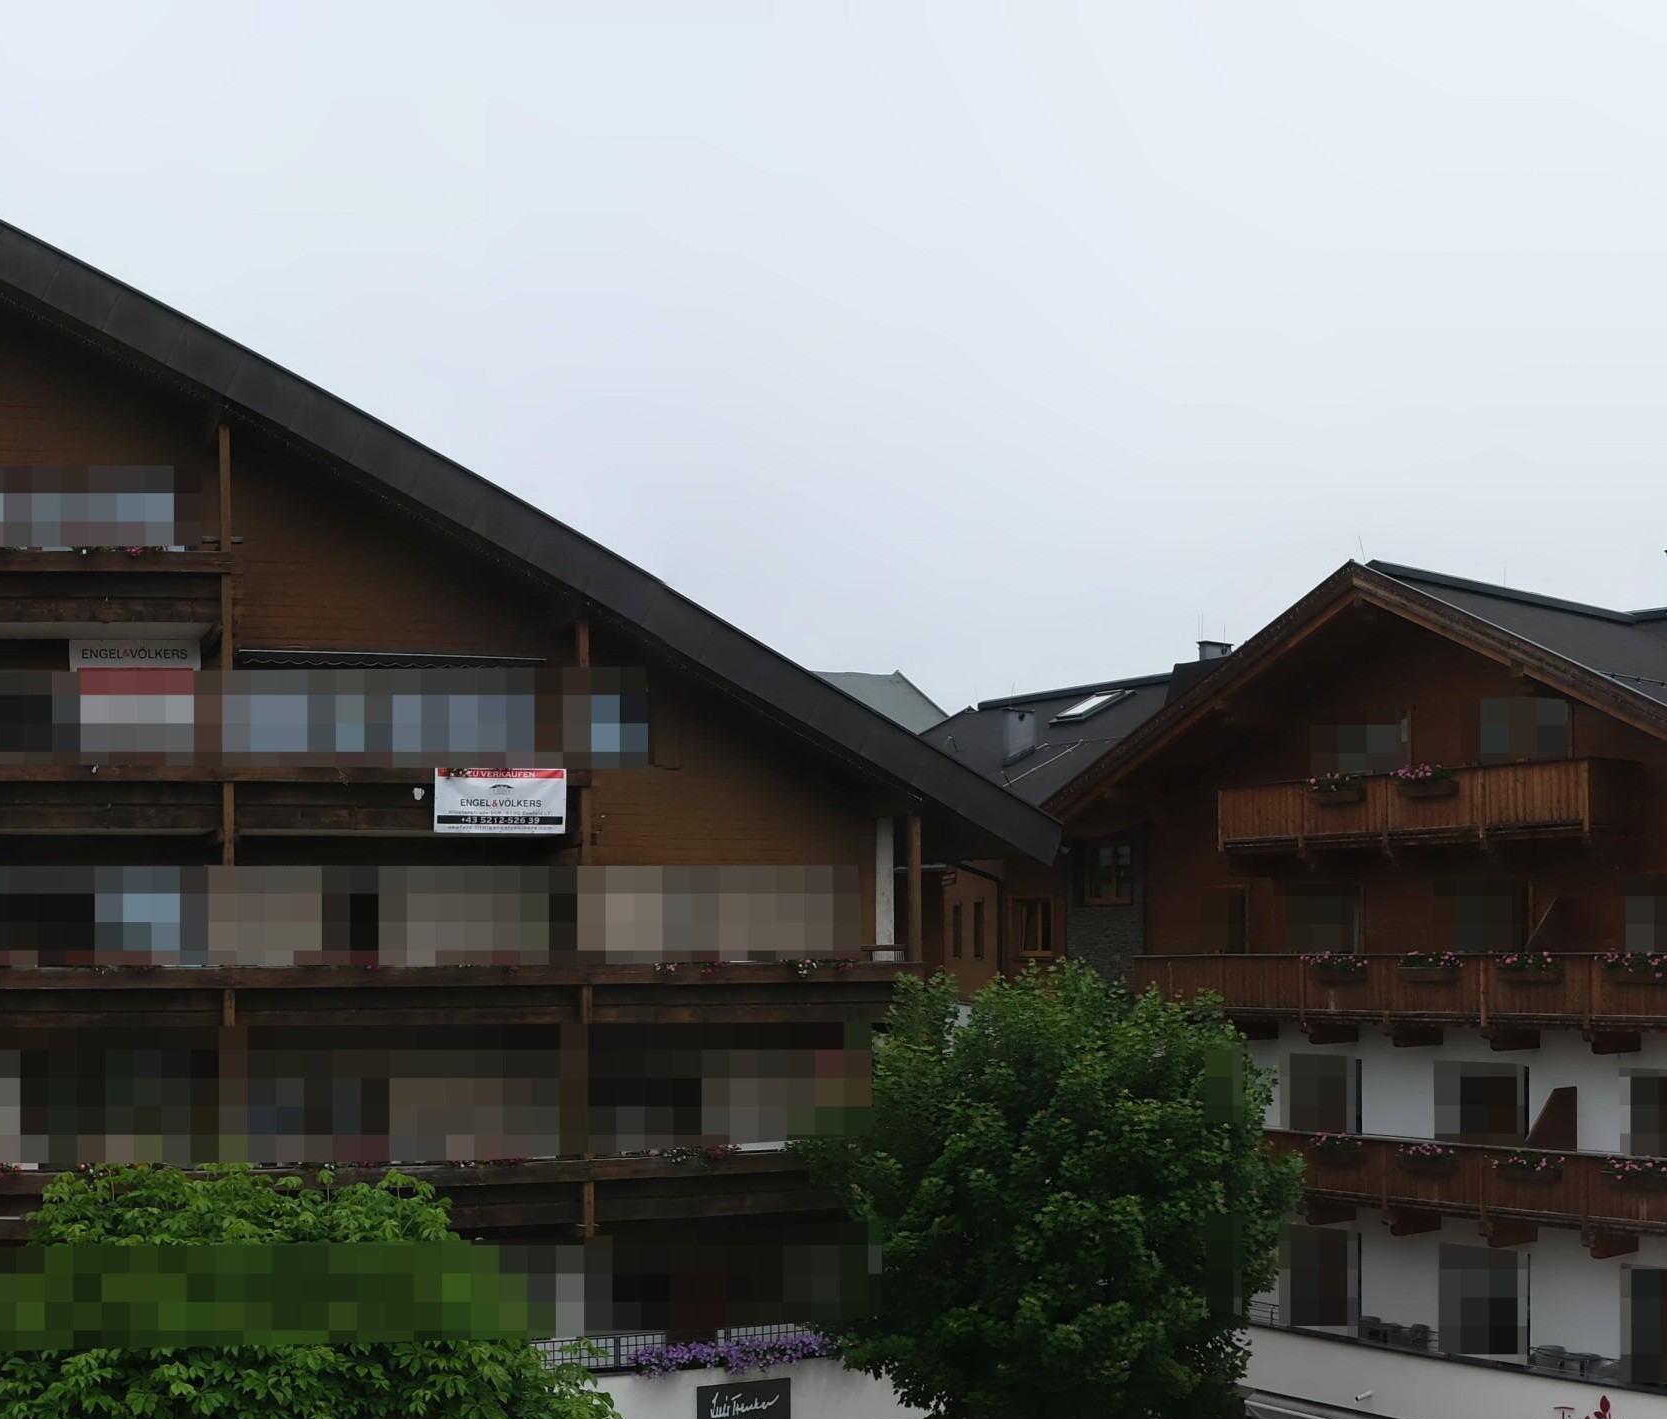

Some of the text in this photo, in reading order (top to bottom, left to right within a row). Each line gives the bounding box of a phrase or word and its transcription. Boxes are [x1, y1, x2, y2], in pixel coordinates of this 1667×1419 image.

[81, 646, 188, 660] ENGEL&VÖLKERS
[480, 770, 536, 778] VERKAUFEN
[460, 798, 542, 808] ENGEL&VÖLKERS
